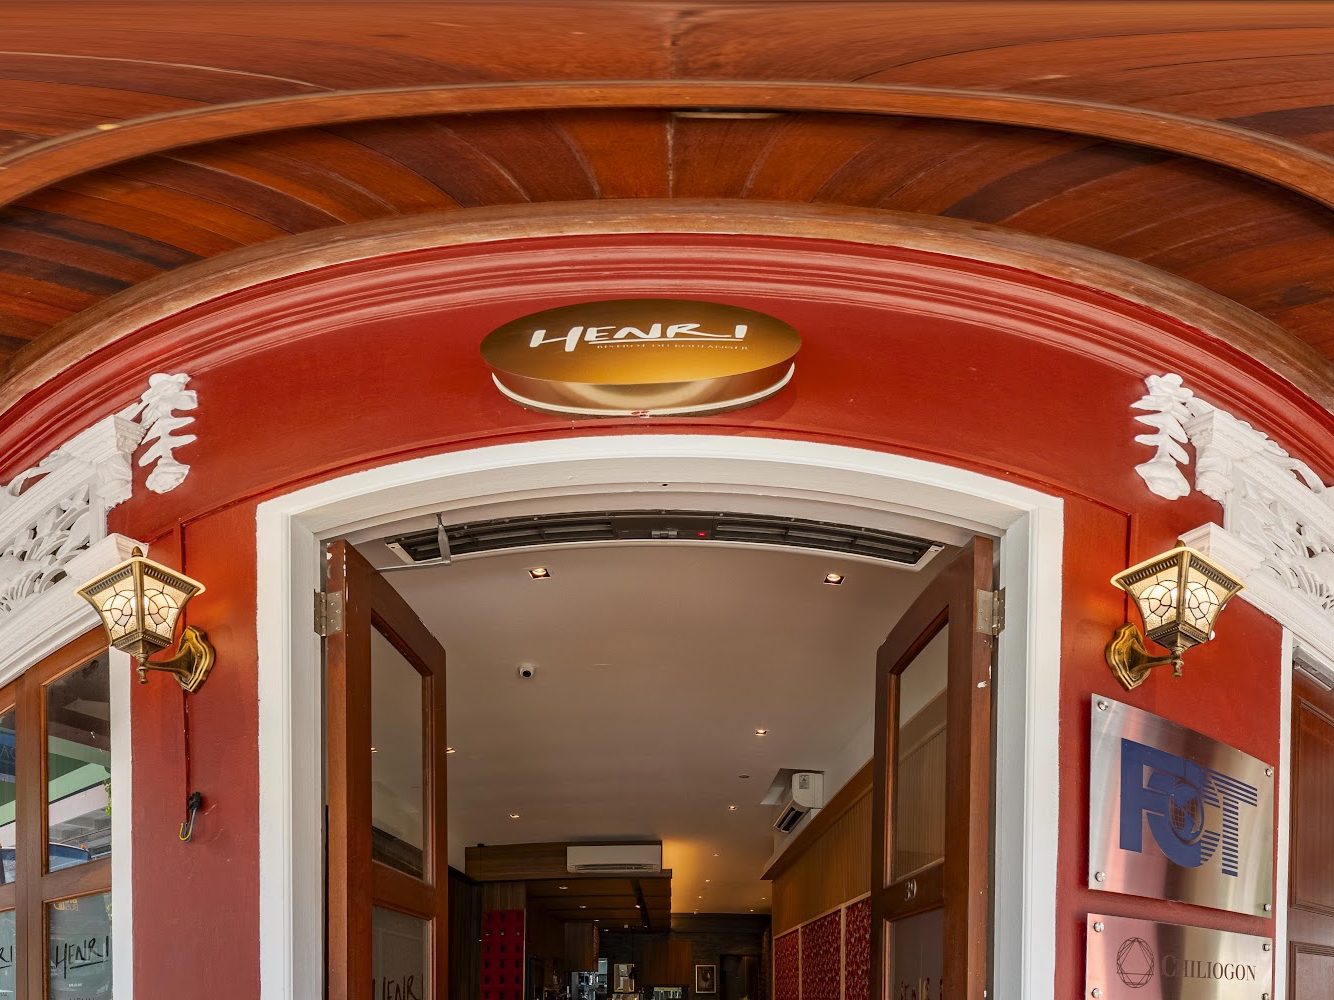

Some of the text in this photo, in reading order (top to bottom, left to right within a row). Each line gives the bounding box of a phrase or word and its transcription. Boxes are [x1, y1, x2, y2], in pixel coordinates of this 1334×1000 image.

[529, 323, 748, 352] HENRI
[1119, 737, 1258, 877] FCT
[904, 879, 917, 900] 39
[55, 935, 109, 979] HENRI
[1161, 954, 1257, 982] CHILIOGON
